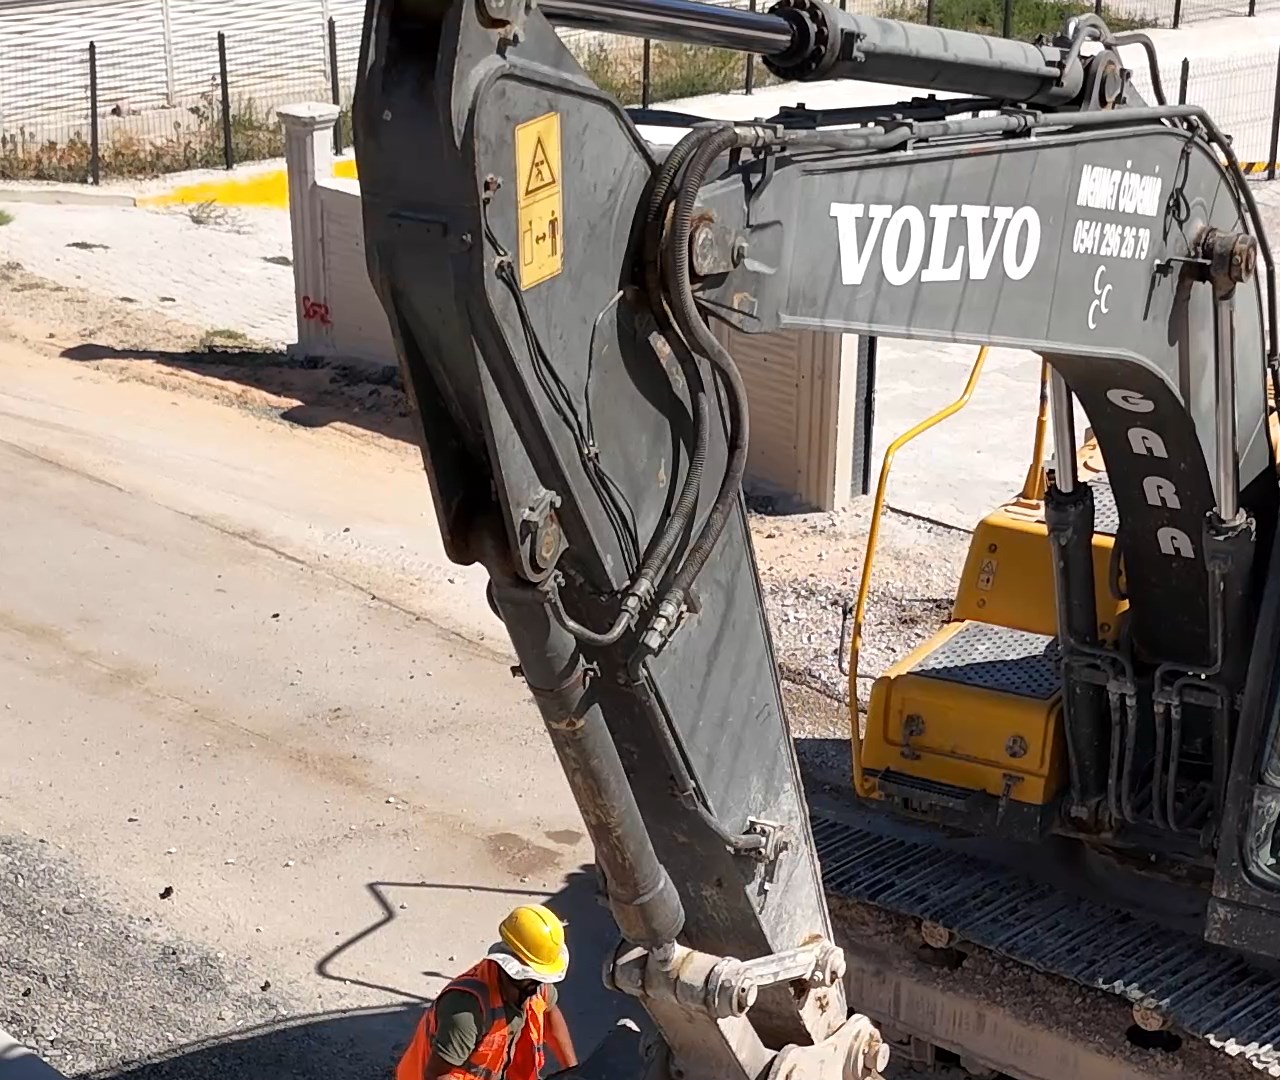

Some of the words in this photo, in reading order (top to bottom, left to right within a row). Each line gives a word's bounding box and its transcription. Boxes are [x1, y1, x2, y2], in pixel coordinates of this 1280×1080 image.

[829, 202, 1041, 286] VOLVO
[1072, 219, 1102, 255] 0541
[1099, 223, 1122, 257] 296
[1119, 225, 1136, 259] 26
[1135, 227, 1151, 260] 79
[1106, 388, 1195, 559] GARA
